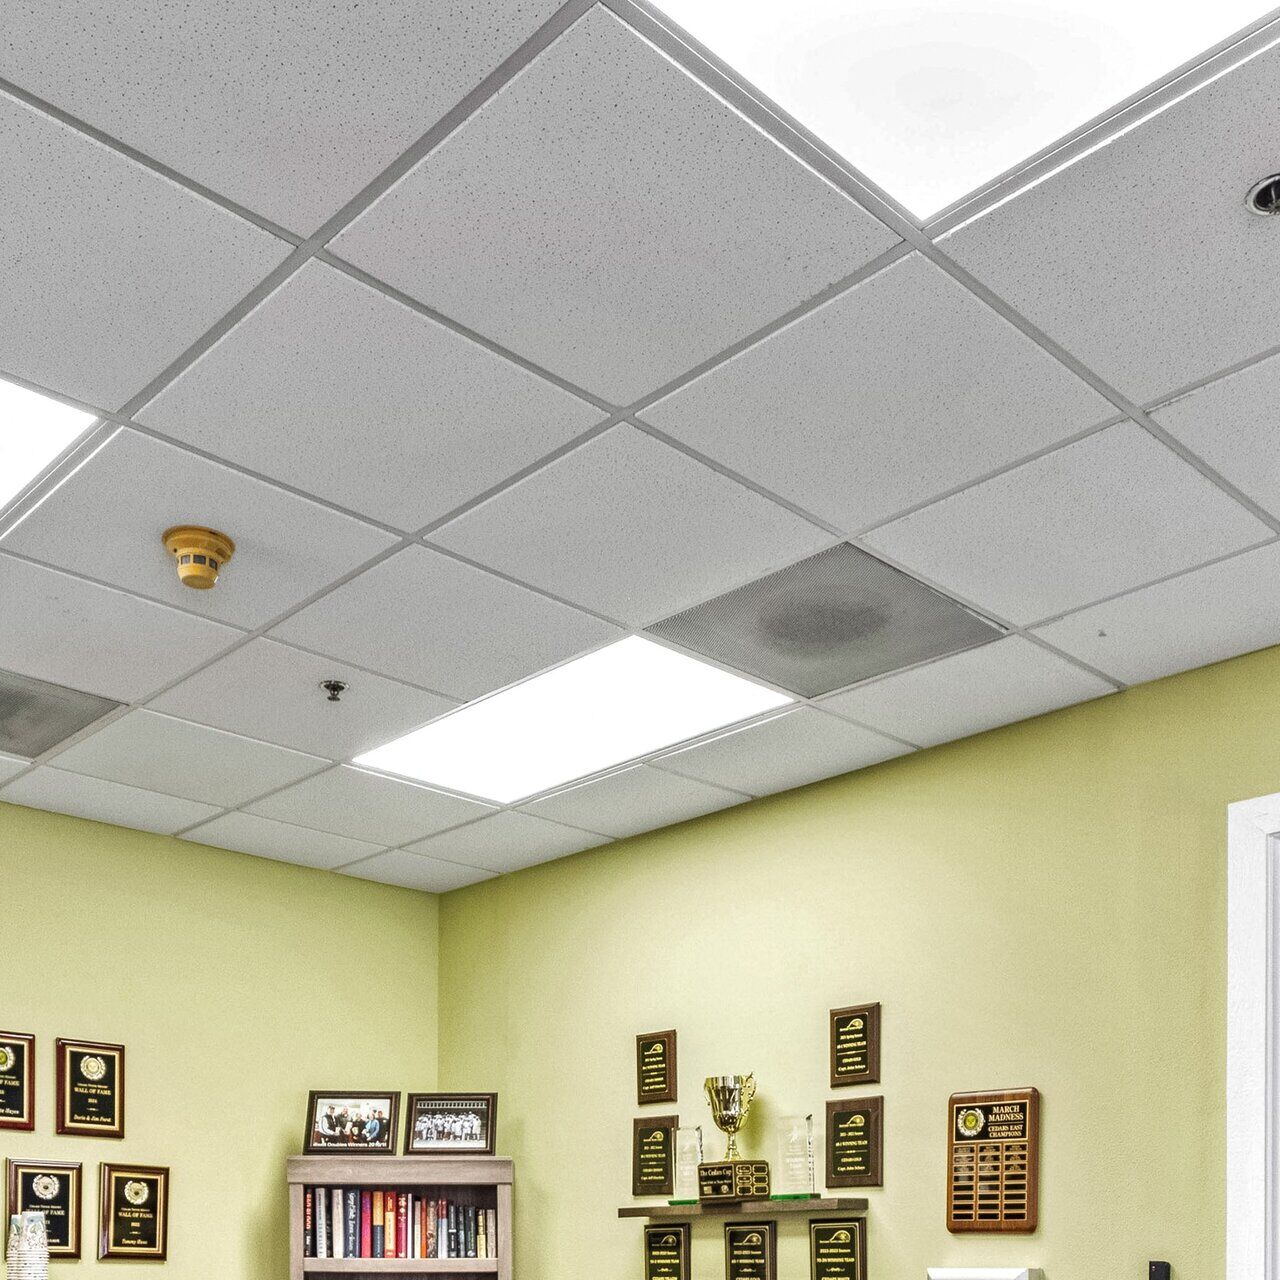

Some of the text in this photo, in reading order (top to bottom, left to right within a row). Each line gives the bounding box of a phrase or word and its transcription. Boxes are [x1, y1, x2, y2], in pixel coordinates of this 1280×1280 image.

[74, 1086, 89, 1094] WALL
[992, 1105, 1020, 1114] MARCH
[988, 1112, 1024, 1122] MADNESS
